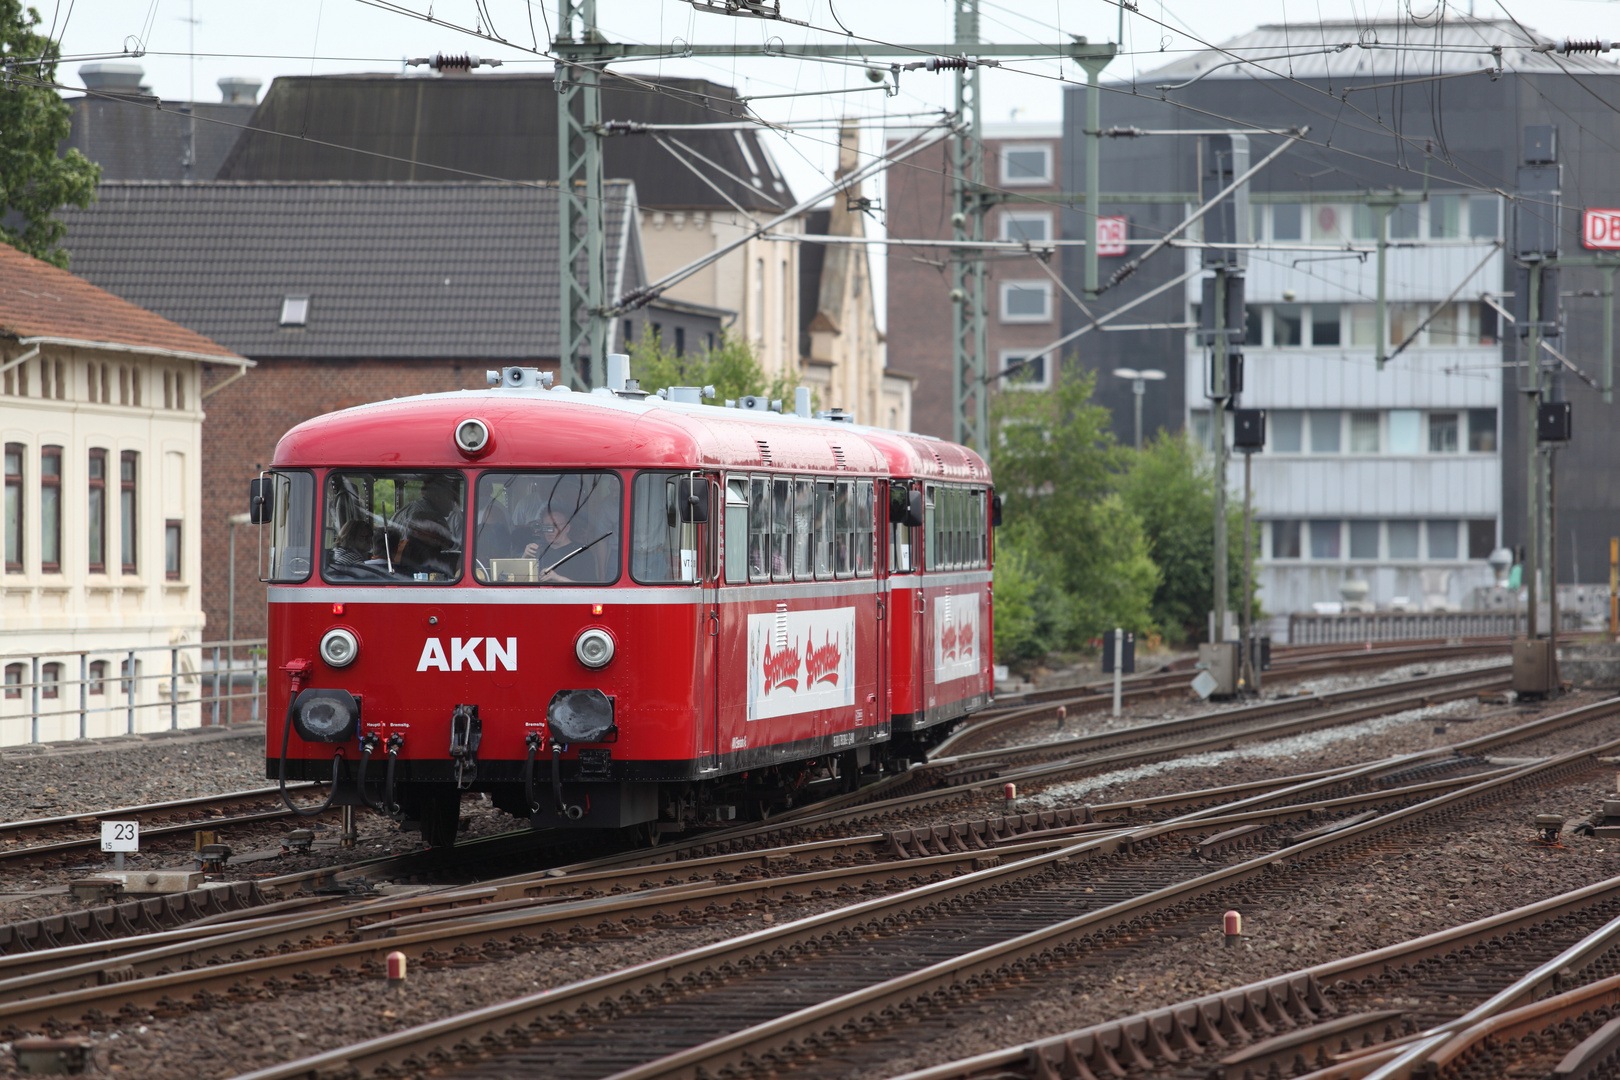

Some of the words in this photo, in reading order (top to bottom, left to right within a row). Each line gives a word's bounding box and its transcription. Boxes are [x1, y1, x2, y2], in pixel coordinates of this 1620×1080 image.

[1098, 223, 1122, 248] DB
[1592, 215, 1620, 240] DB
[416, 637, 517, 671] AKN
[114, 823, 135, 841] 23
[105, 842, 112, 850] 15
